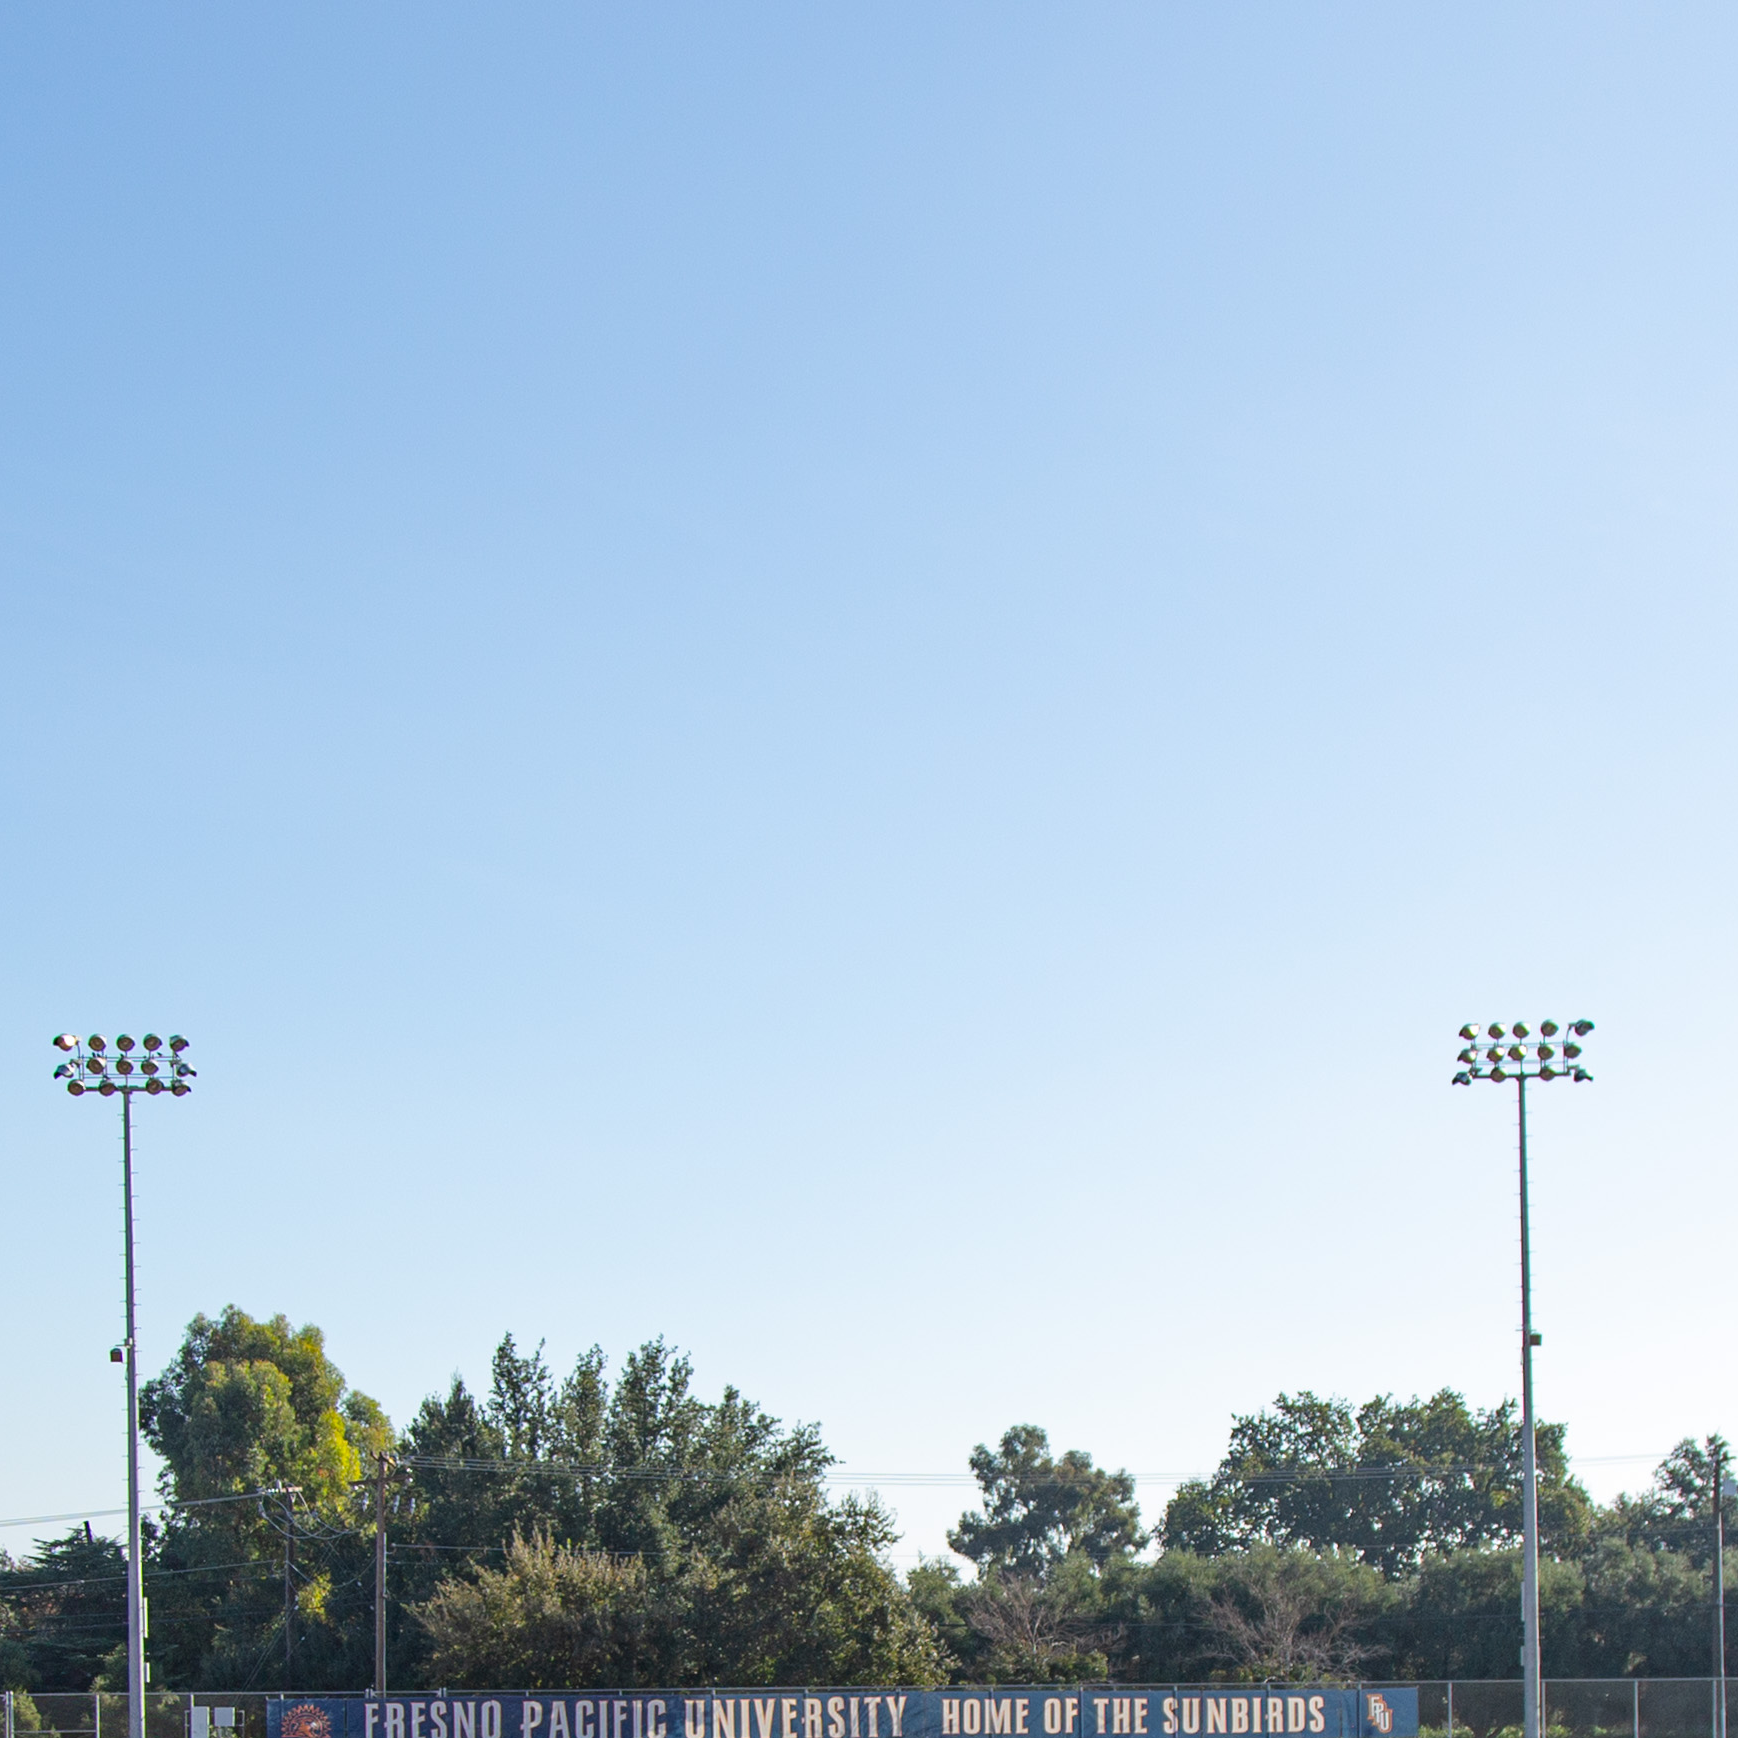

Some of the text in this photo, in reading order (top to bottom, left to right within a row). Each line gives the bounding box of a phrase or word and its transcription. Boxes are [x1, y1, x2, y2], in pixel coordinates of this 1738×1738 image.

[942, 1697, 1029, 1735] HOME
[1043, 1697, 1079, 1735] OF
[1093, 1697, 1148, 1735] THE
[1163, 1695, 1326, 1735] SUNBIRDS
[1367, 1694, 1393, 1733] FPU
